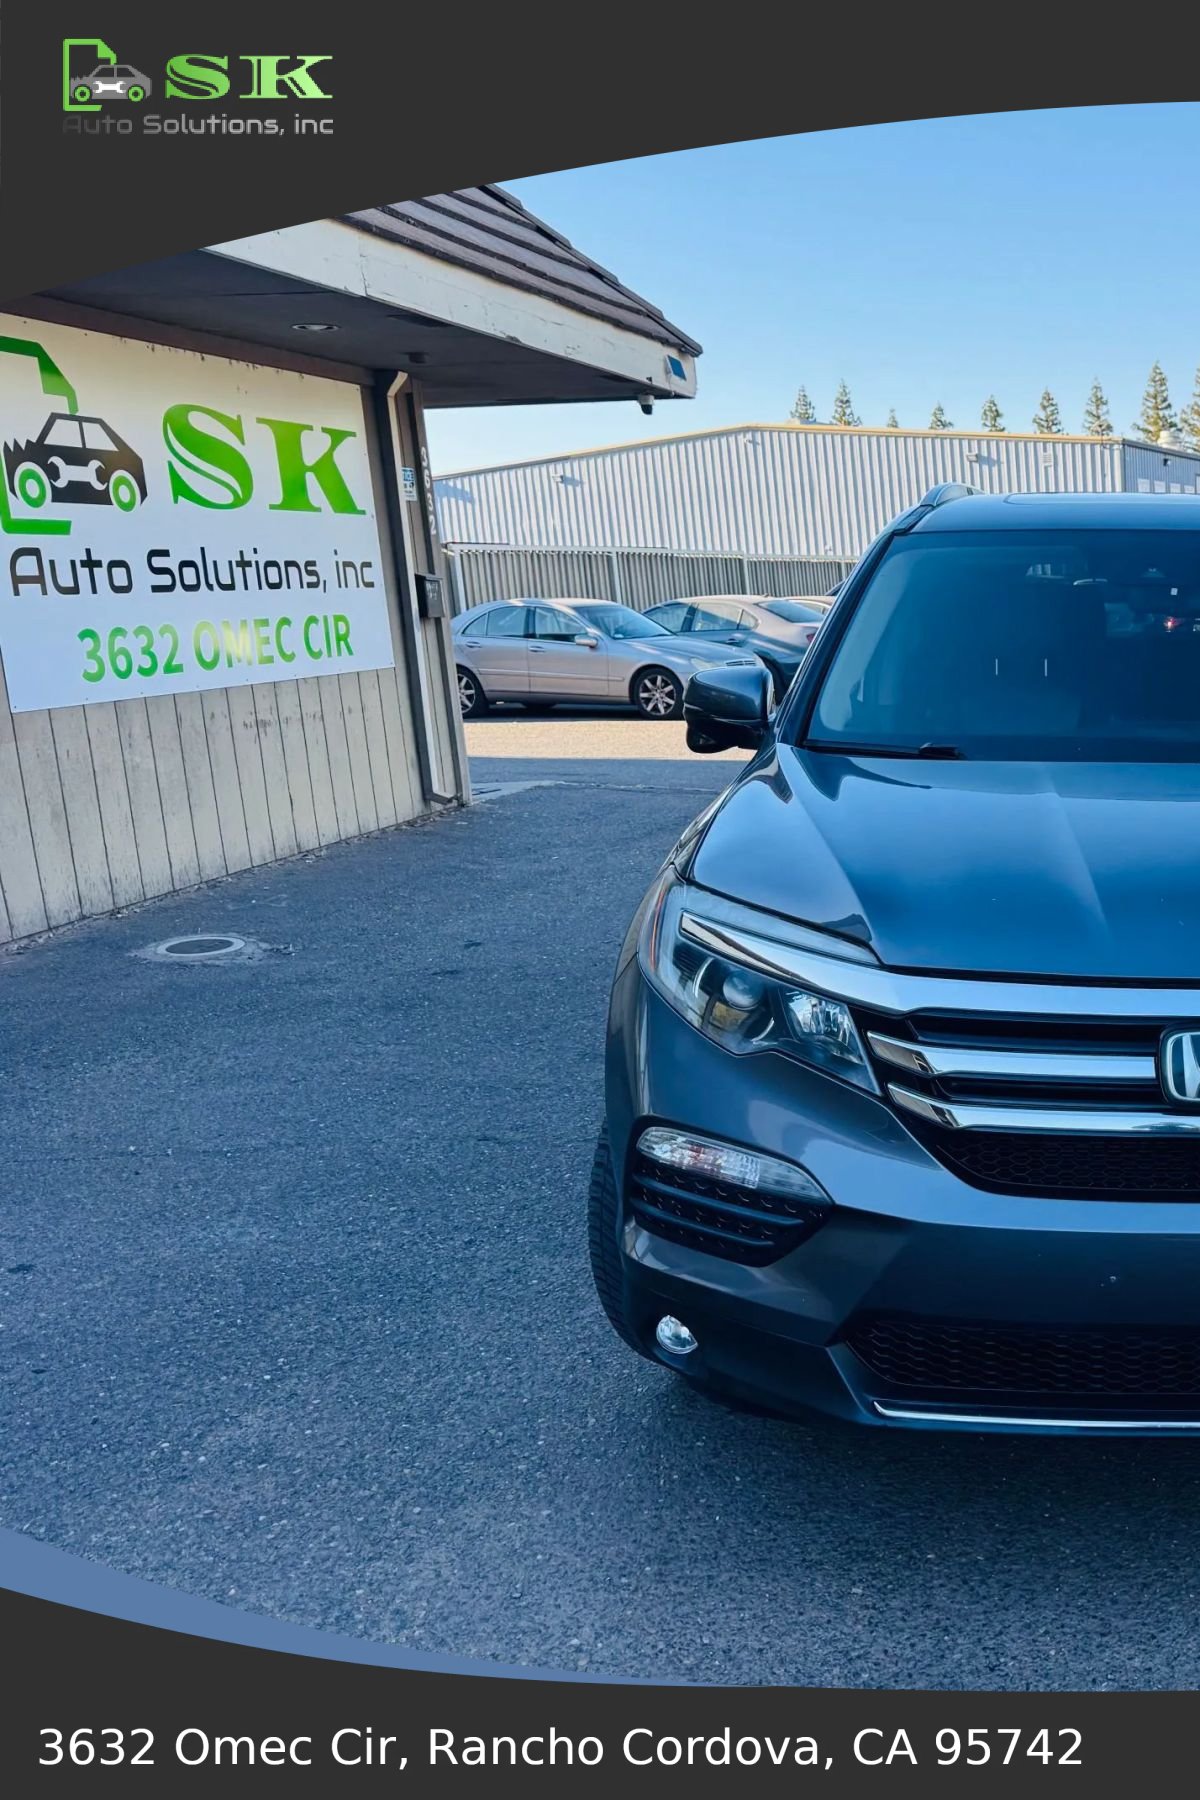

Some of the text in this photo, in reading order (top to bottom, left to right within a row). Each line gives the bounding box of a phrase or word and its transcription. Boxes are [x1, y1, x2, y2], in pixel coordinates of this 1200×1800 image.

[162, 404, 366, 515] SK
[10, 547, 375, 596] Auto Solutions, inc
[77, 614, 354, 683] 3632 OMEC CIR
